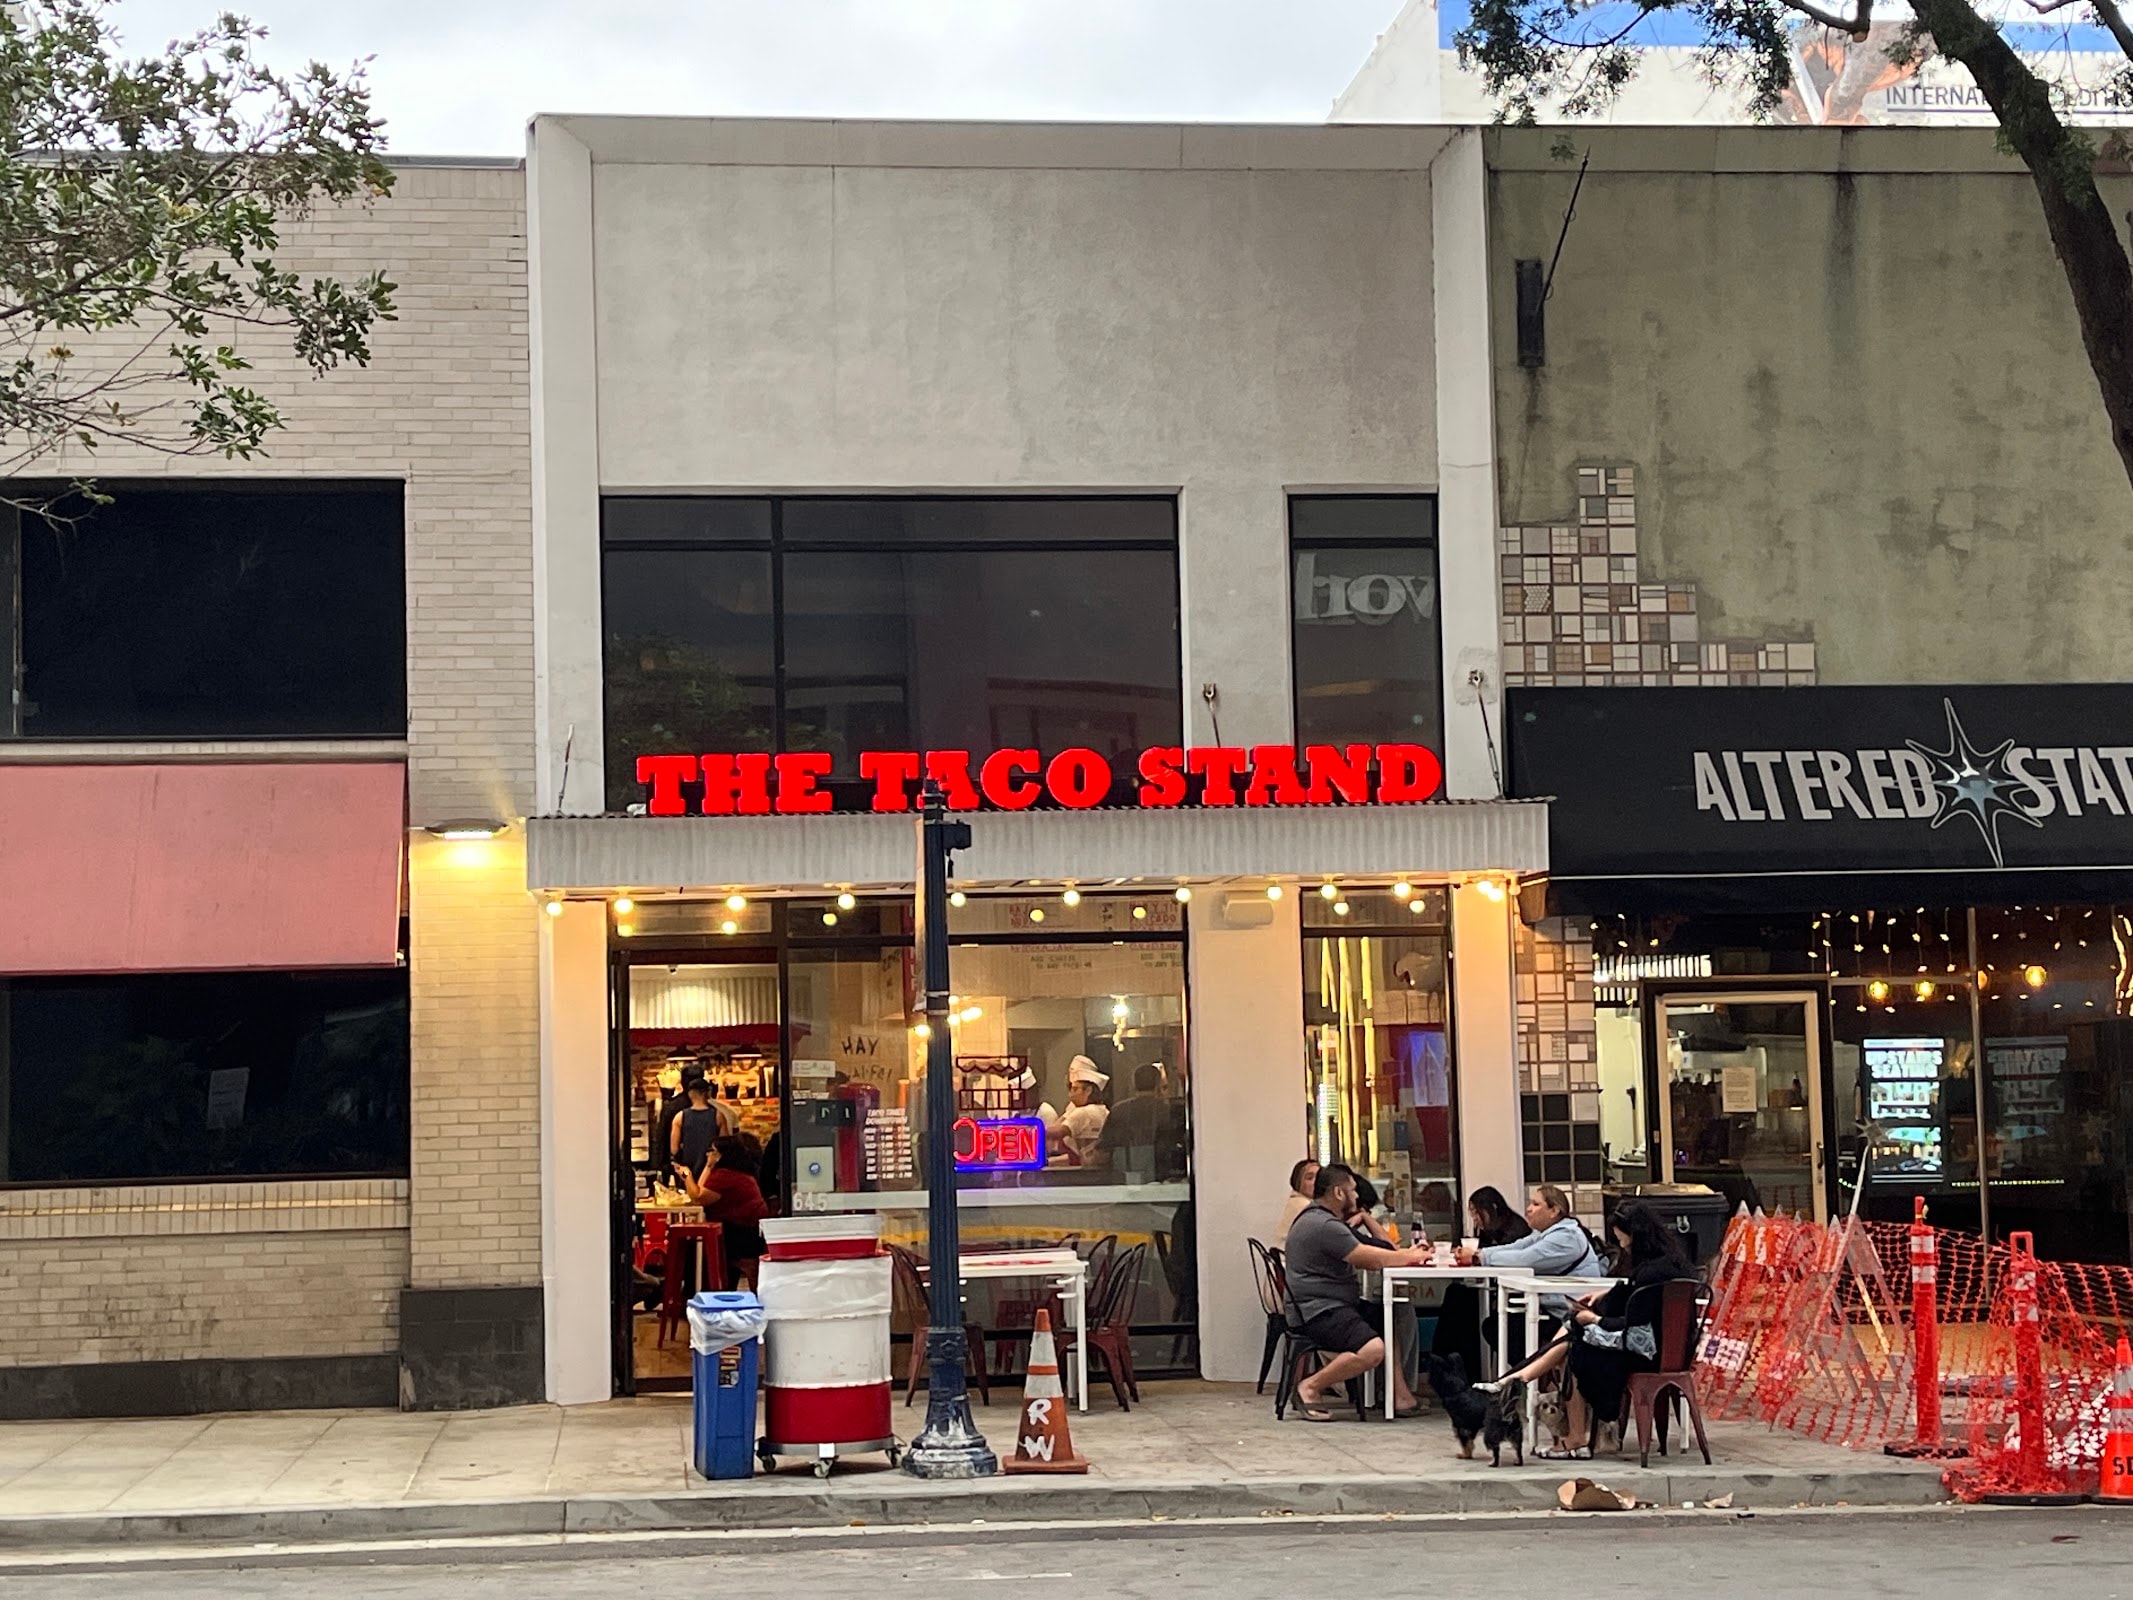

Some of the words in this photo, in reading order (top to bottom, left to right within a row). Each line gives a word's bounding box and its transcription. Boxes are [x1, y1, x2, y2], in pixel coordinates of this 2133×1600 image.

[636, 753, 834, 815] THE
[860, 749, 1112, 811] TACO
[1138, 744, 1442, 806] STAND
[1693, 749, 1940, 821] ALTERED
[2006, 746, 2133, 817] STAT
[842, 1036, 880, 1057] HAY
[951, 1117, 1038, 1162] OPEN
[792, 1191, 829, 1212] 645
[1027, 1398, 1052, 1426] R
[1021, 1433, 1055, 1462] W
